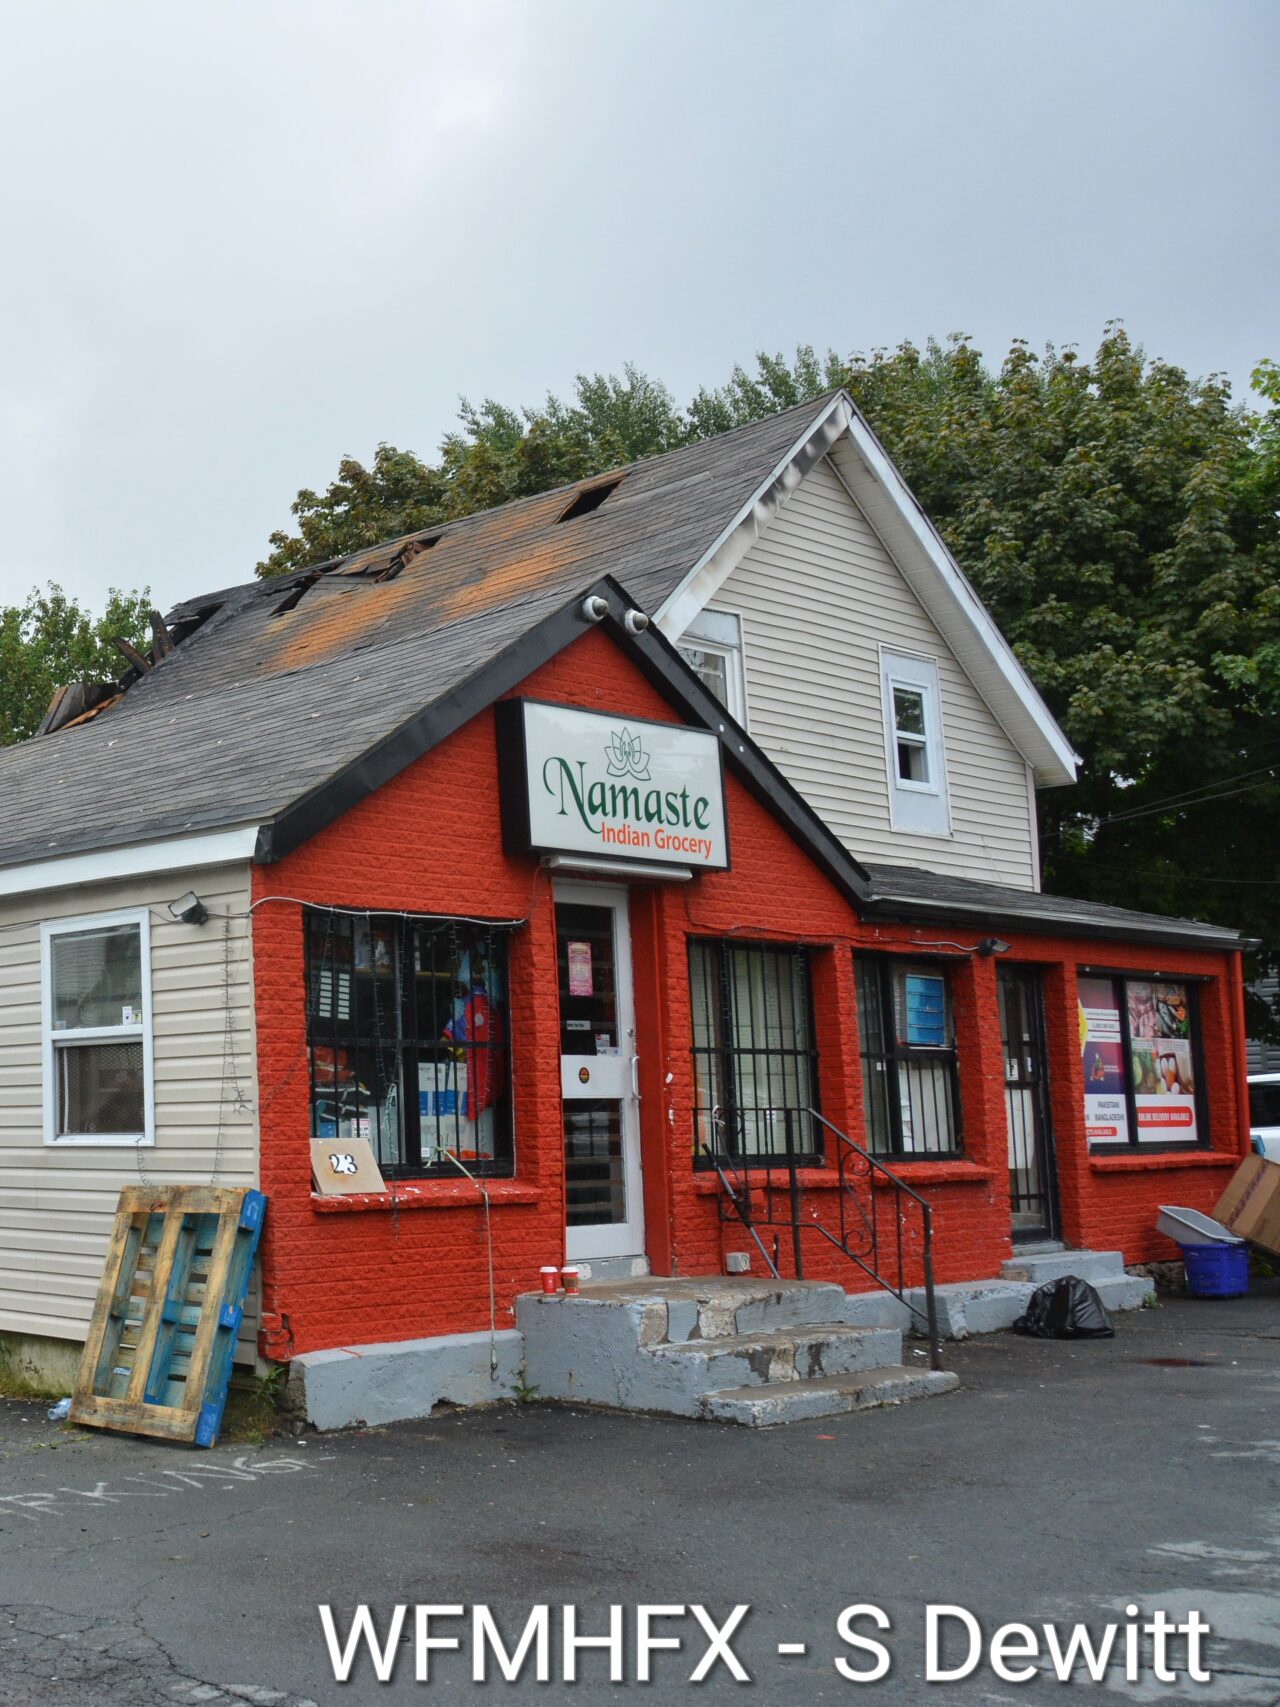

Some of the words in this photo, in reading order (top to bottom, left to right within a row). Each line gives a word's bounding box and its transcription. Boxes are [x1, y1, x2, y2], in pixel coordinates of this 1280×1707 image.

[543, 756, 710, 834] Namaste
[601, 821, 651, 848] Indian
[654, 829, 712, 859] Grocery
[1170, 1112, 1190, 1121] AVAILABLE
[328, 1153, 359, 1174] 23
